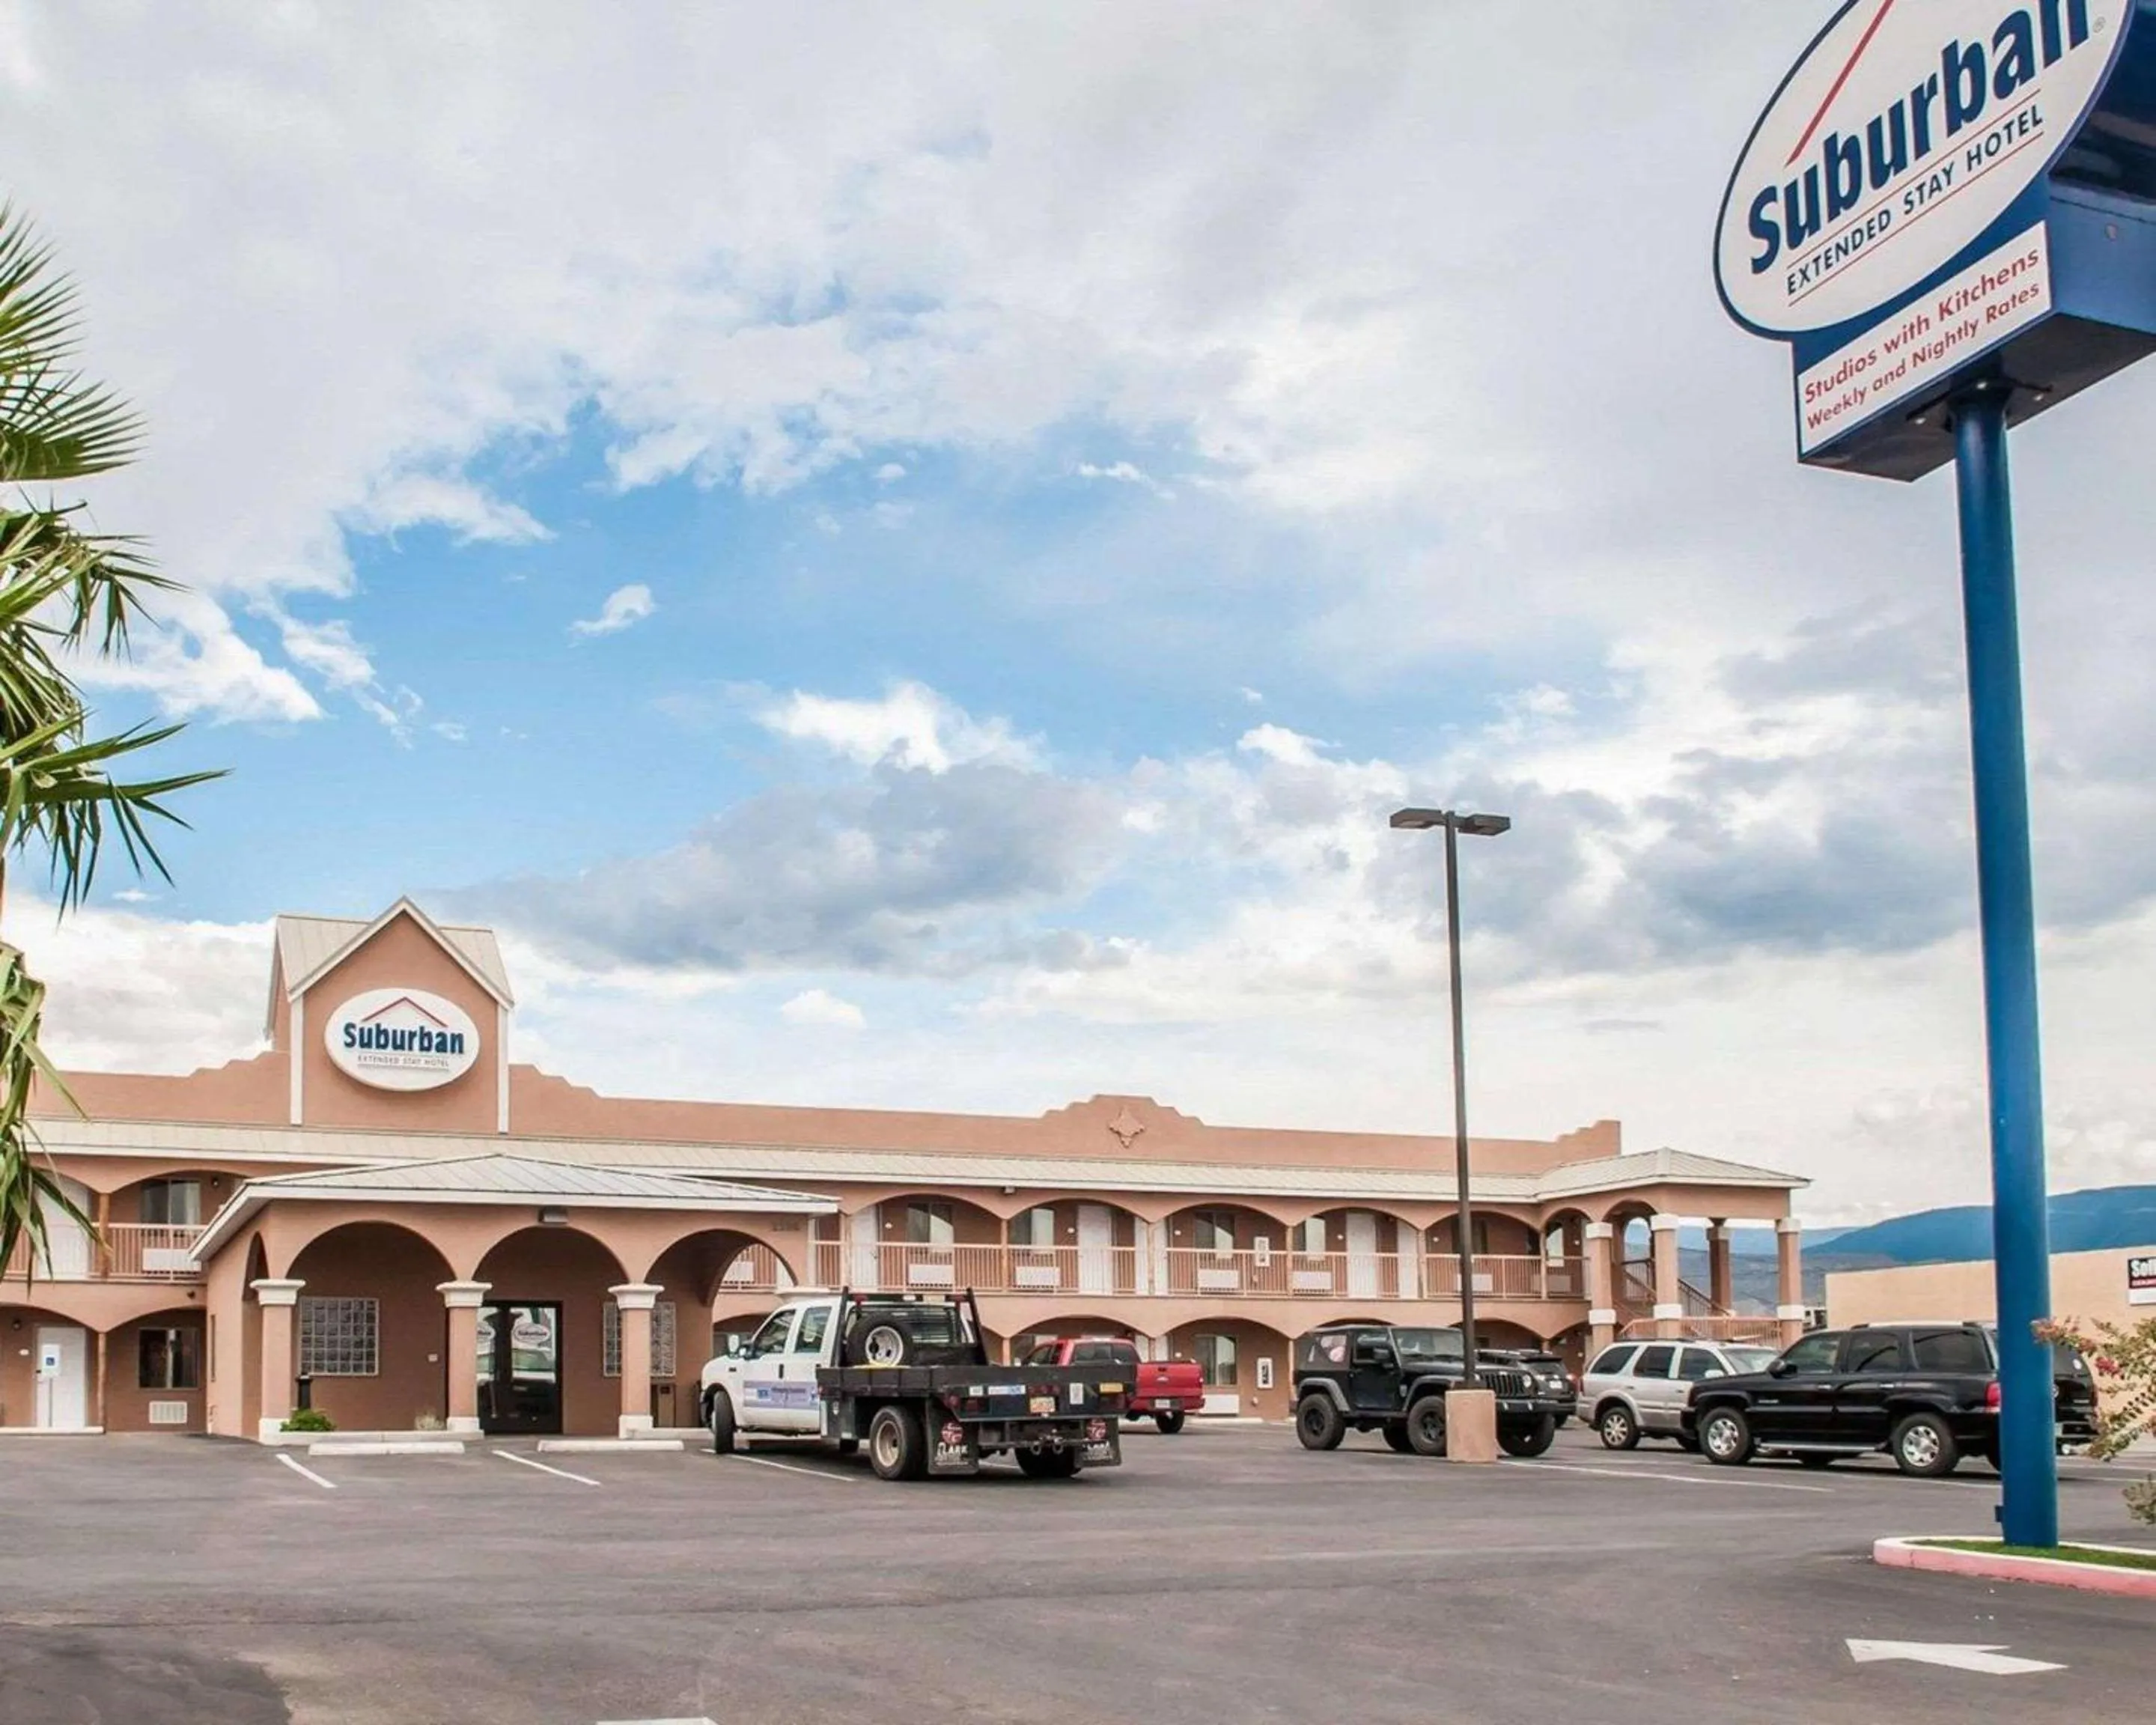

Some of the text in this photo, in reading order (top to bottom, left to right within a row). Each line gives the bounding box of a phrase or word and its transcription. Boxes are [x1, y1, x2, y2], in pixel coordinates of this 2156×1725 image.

[1748, 0, 2089, 275] Suburban
[1787, 105, 2044, 296] EXTENDED STAY HOTEL
[1805, 249, 2039, 404] Studios with Kitchens
[1807, 282, 2039, 429] Weekly and Nightly Rates
[344, 1022, 463, 1055] Suburban
[358, 1055, 449, 1067] EXTENDED STAY HOTEL
